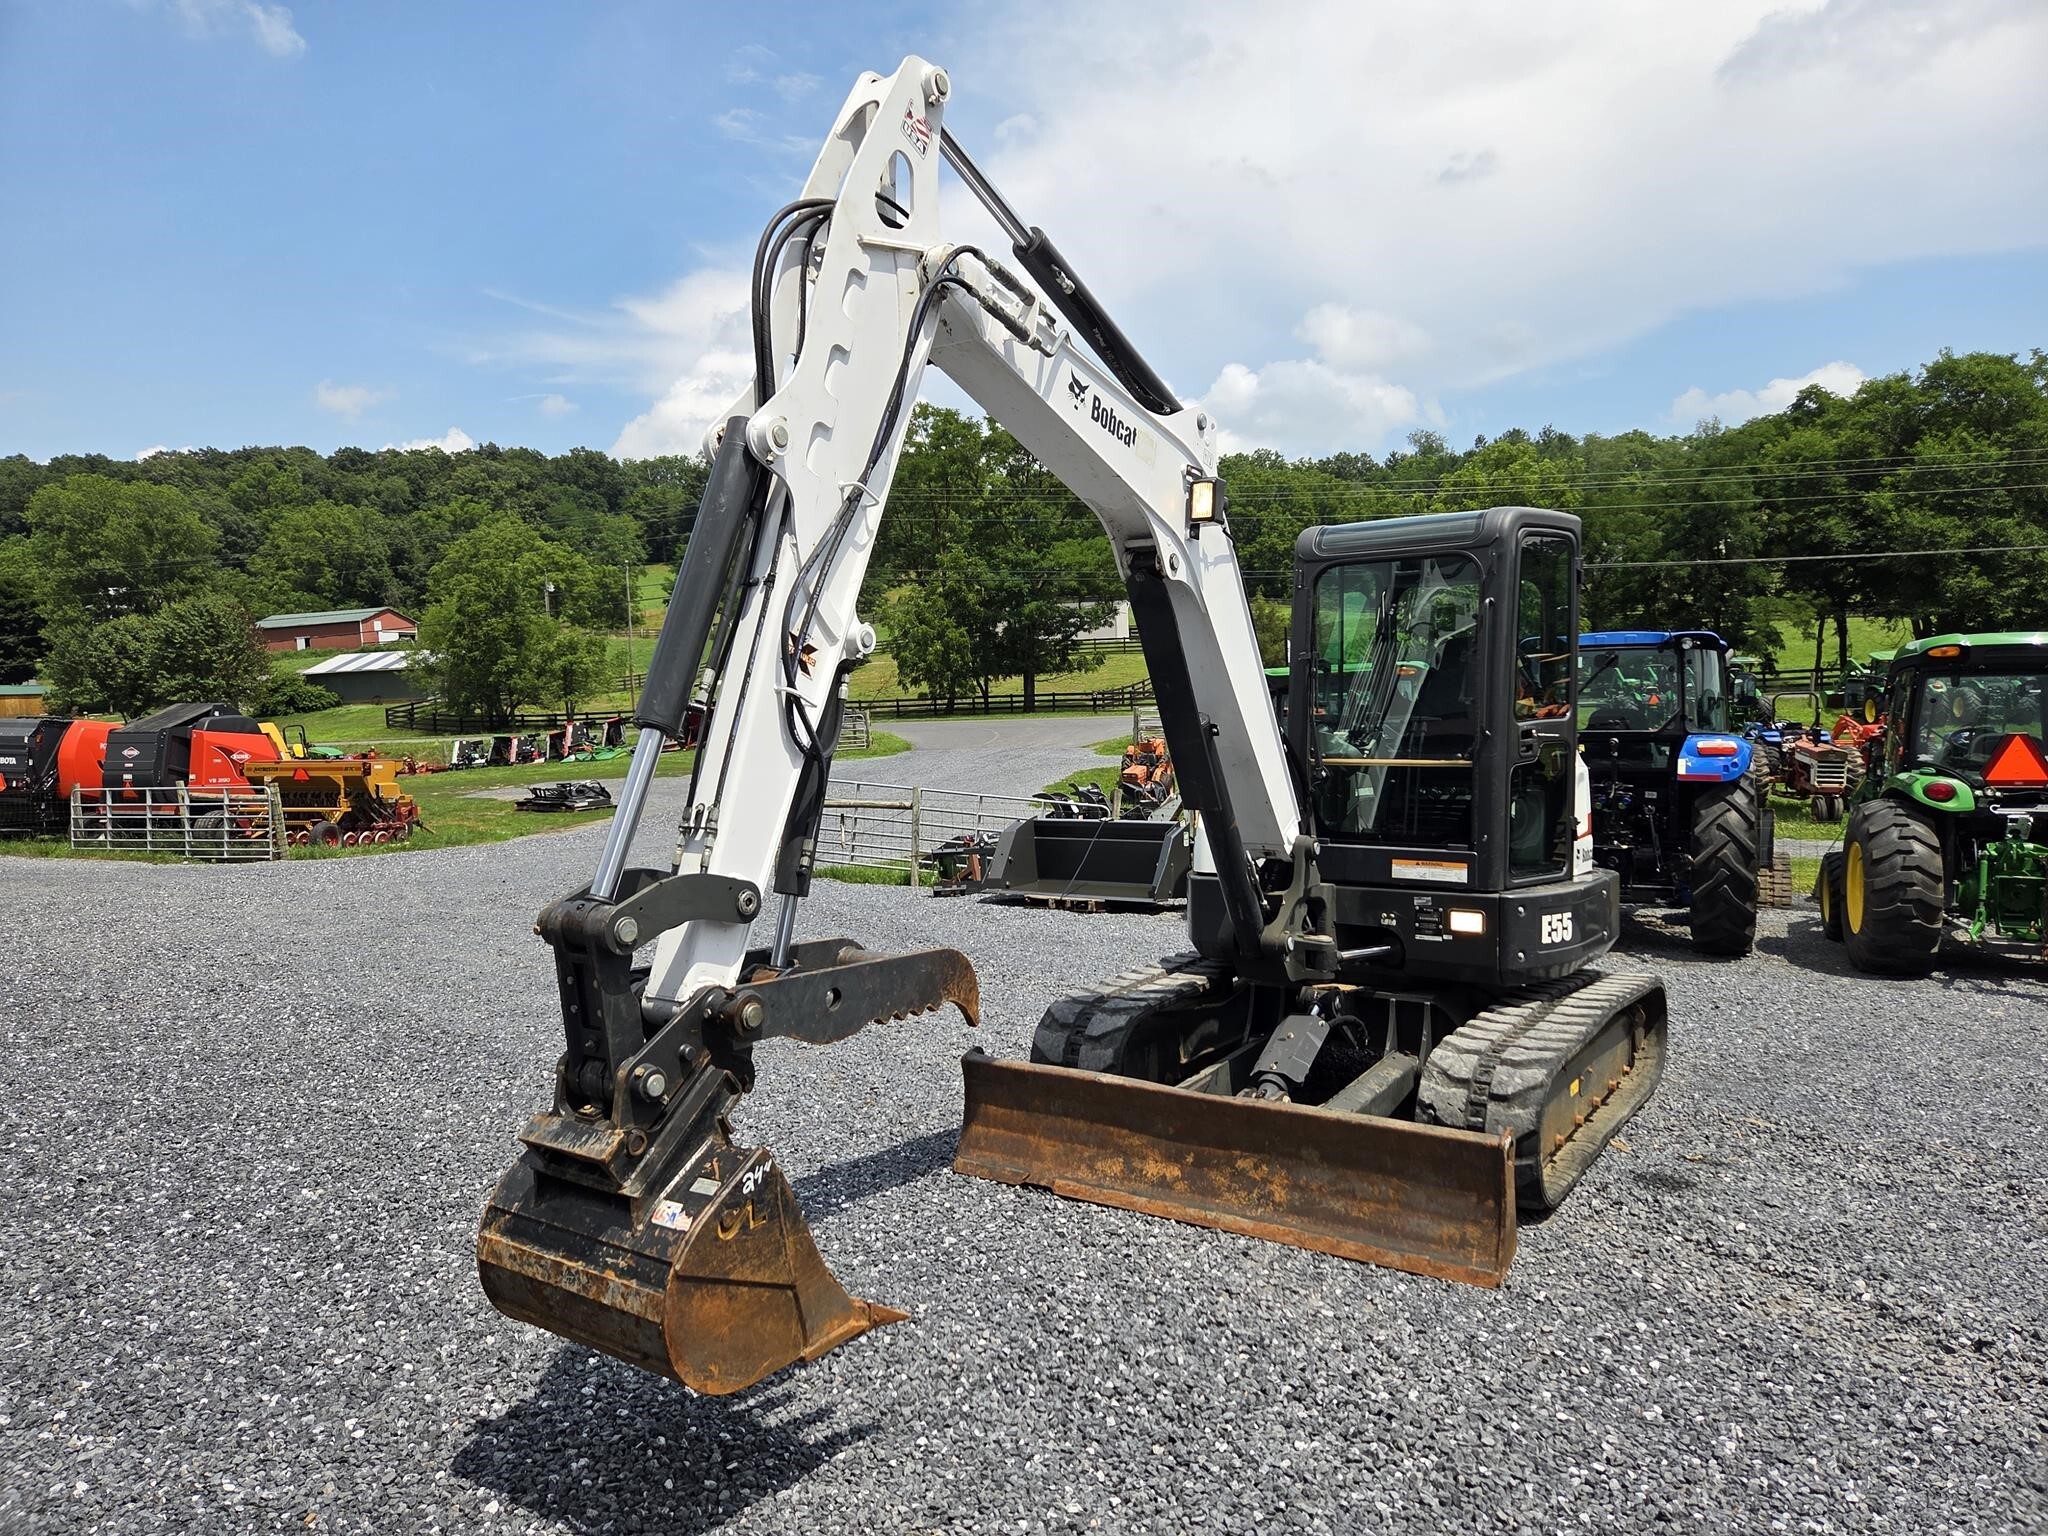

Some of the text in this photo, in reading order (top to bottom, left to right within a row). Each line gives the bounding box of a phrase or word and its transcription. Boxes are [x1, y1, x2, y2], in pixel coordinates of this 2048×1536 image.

[902, 120, 927, 155] USA
[1091, 394, 1137, 449] Bobcat
[1541, 912, 1573, 944] E55
